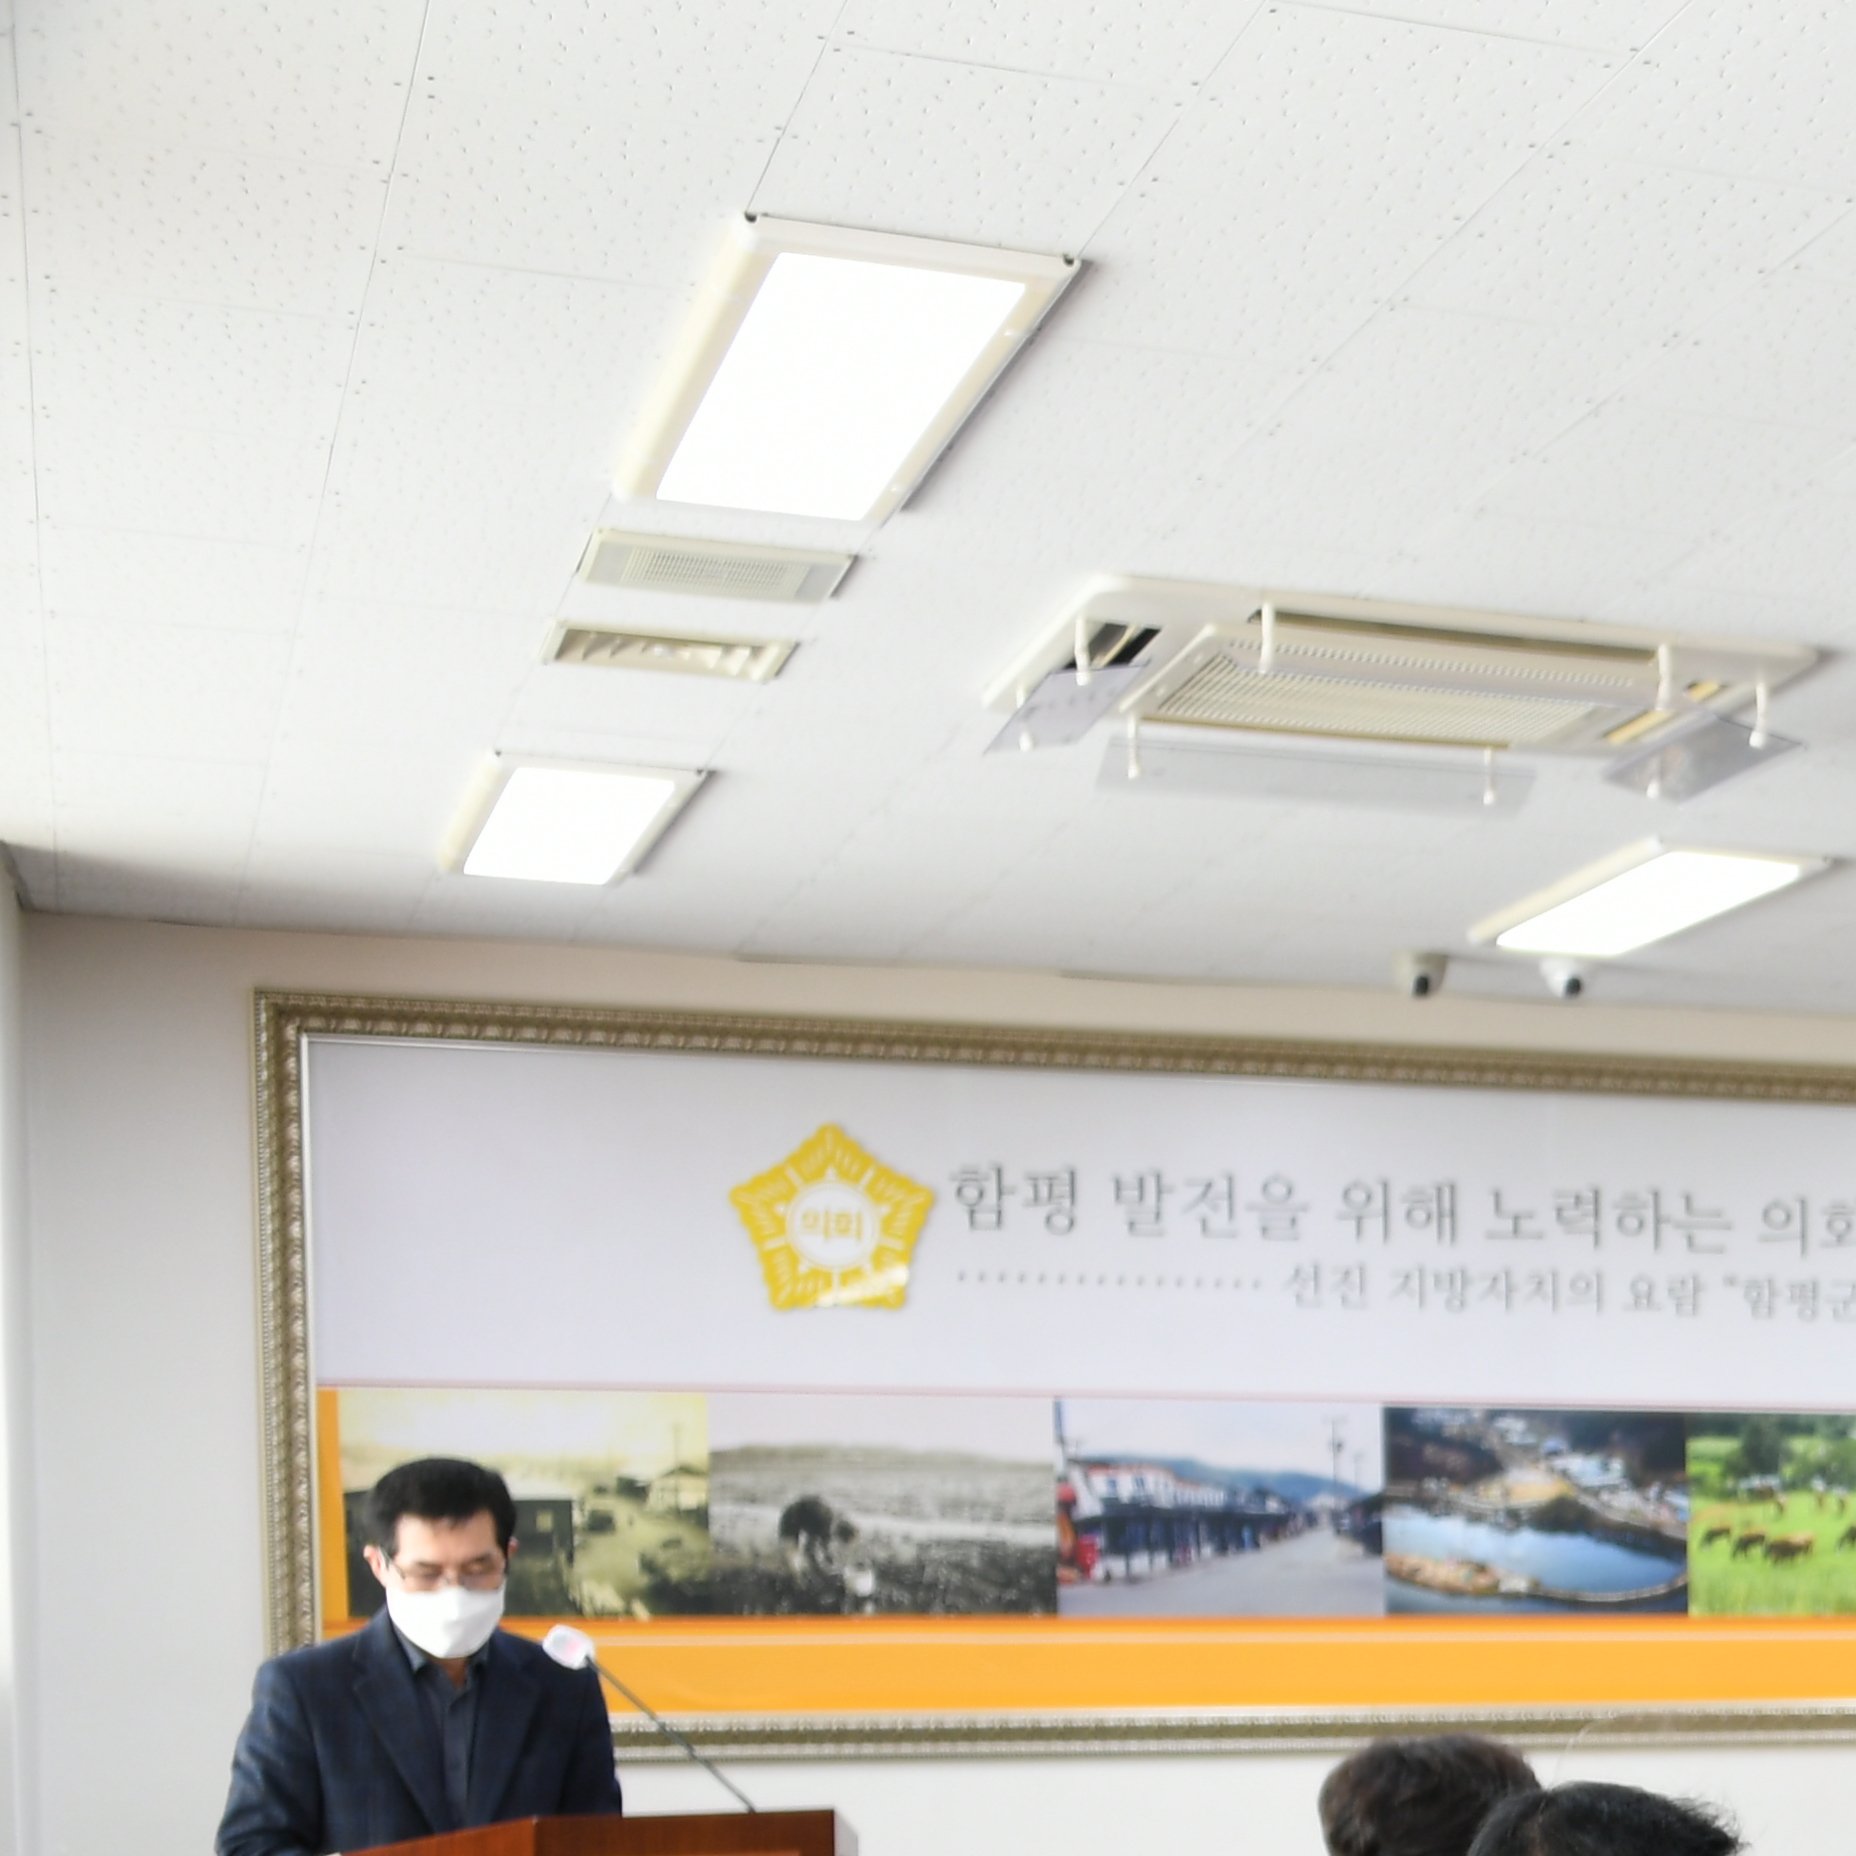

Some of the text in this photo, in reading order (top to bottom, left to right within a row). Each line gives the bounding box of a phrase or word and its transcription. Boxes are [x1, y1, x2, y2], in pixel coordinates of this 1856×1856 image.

[948, 1161, 1080, 1236] 함평
[1112, 1171, 1311, 1241] 발전을
[1335, 1177, 1459, 1244] 위해
[1485, 1186, 1733, 1254] 노력하는
[1283, 1263, 1369, 1310] 선진
[1389, 1266, 1603, 1313] 지방자치의
